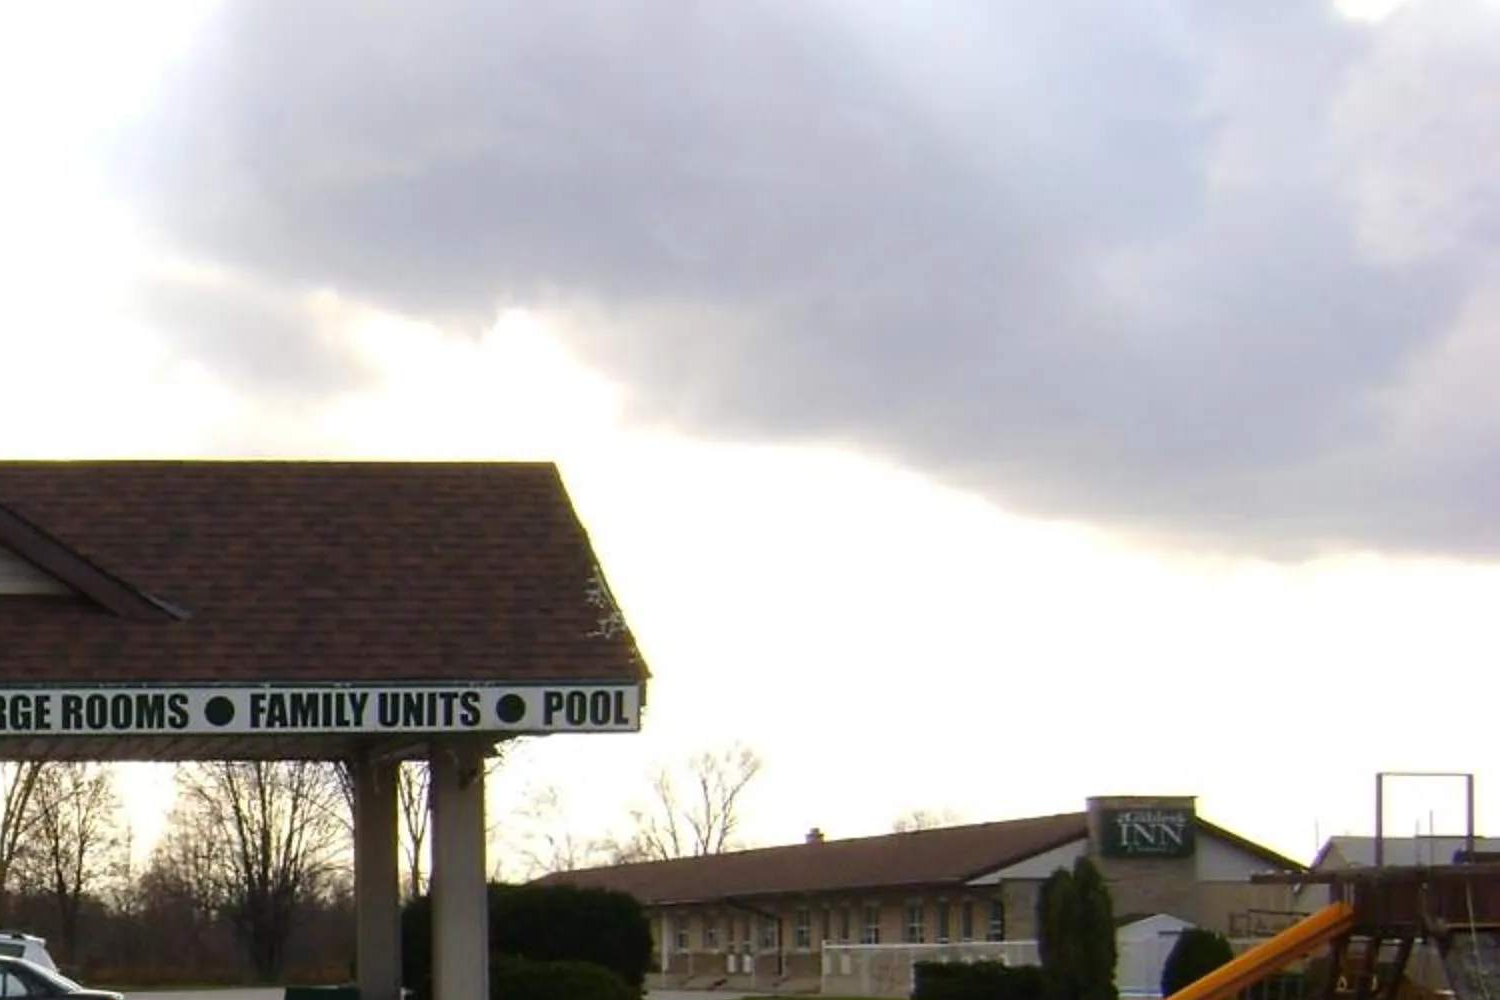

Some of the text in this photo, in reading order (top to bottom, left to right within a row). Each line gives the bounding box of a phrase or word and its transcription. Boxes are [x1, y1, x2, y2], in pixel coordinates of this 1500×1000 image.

[62, 693, 190, 730] ROOMS
[249, 691, 369, 728] FAMILY
[378, 691, 481, 727] UNITS
[543, 690, 629, 726] POOL
[1119, 823, 1186, 846] INN
